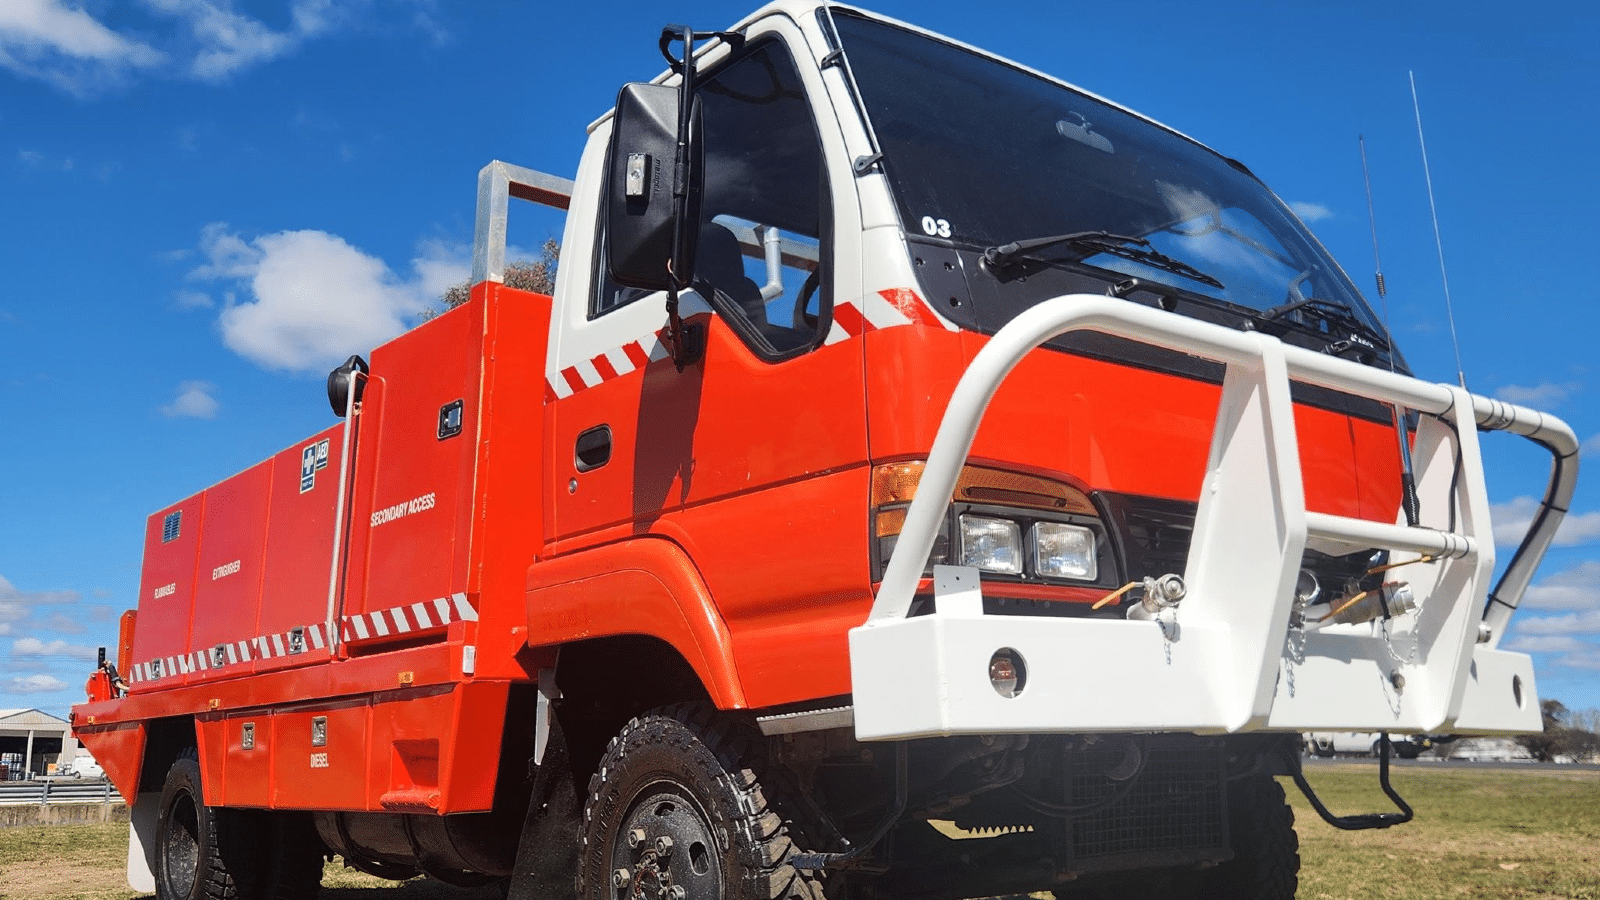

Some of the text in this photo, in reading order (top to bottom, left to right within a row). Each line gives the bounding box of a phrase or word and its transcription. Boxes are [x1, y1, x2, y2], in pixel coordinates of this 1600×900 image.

[921, 215, 952, 238] 03
[317, 442, 328, 460] AED
[370, 492, 436, 527] SECONDARY ACCESS
[310, 752, 329, 769] DIESEL
